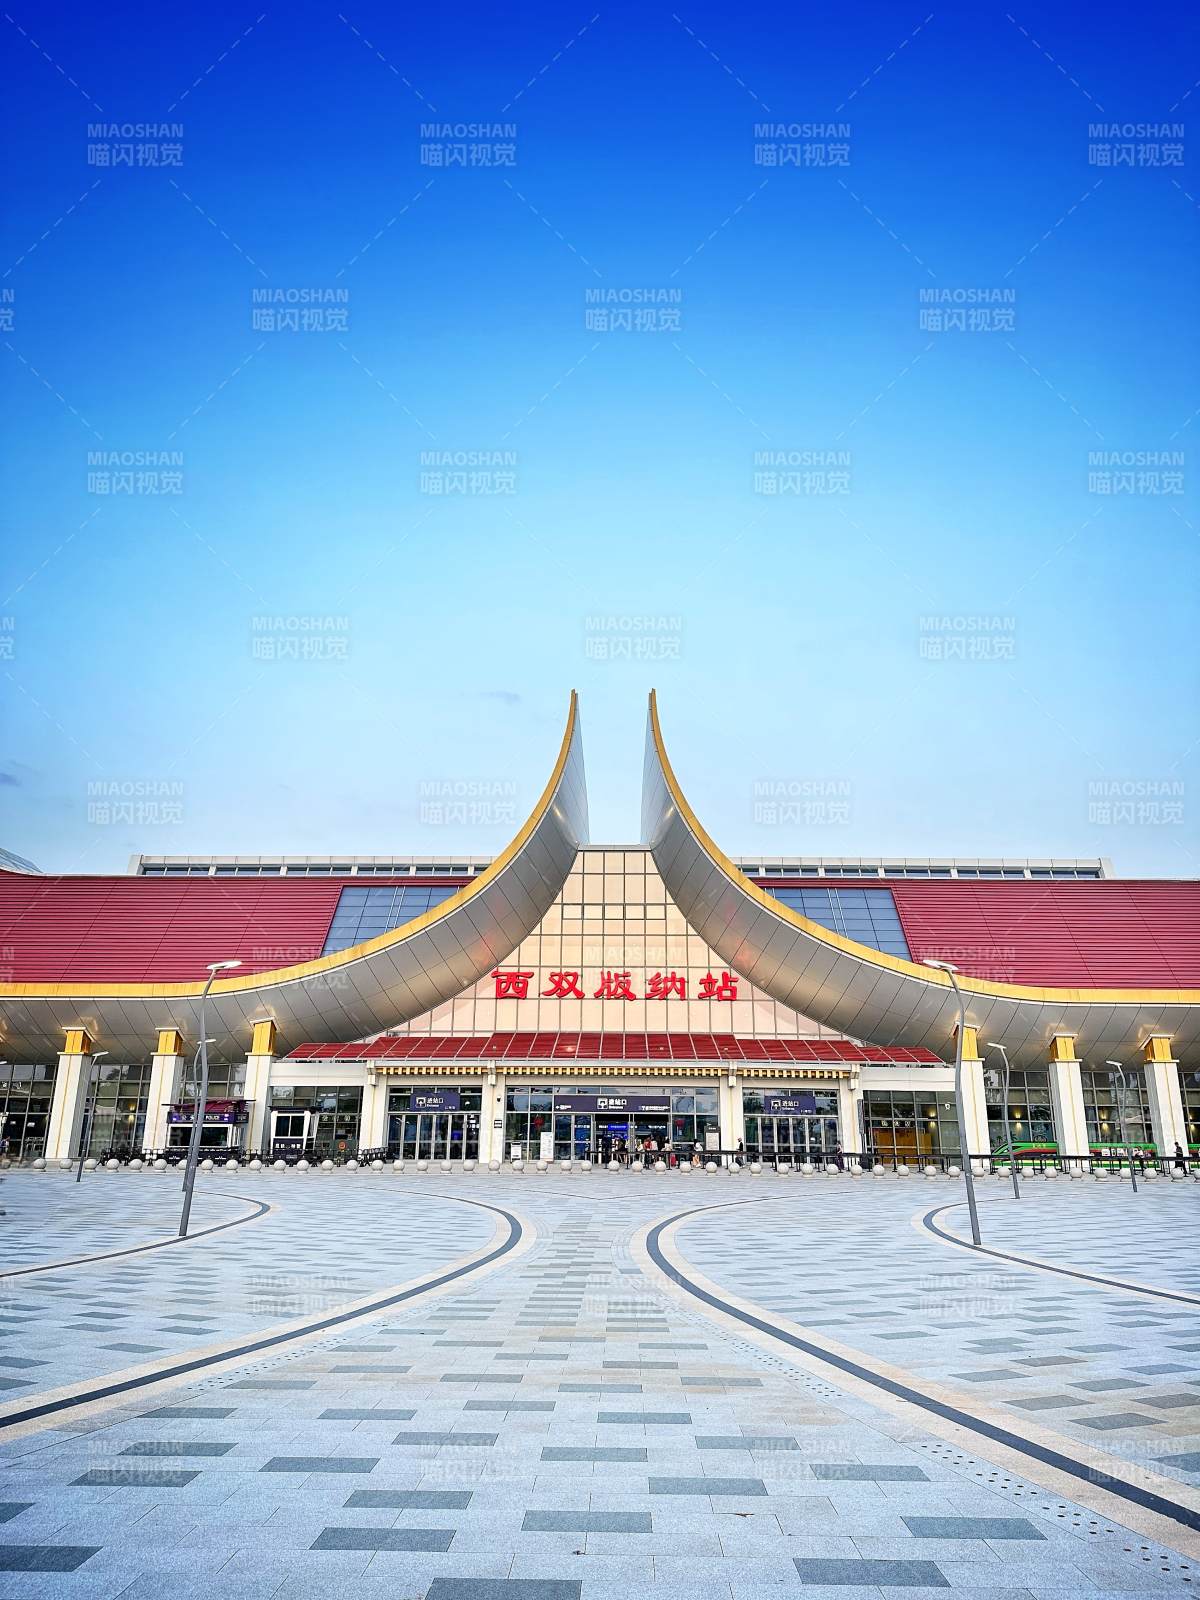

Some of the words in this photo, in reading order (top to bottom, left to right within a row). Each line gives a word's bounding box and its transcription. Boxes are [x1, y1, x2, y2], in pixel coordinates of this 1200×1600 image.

[491, 971, 739, 1001] 西双版纳站
